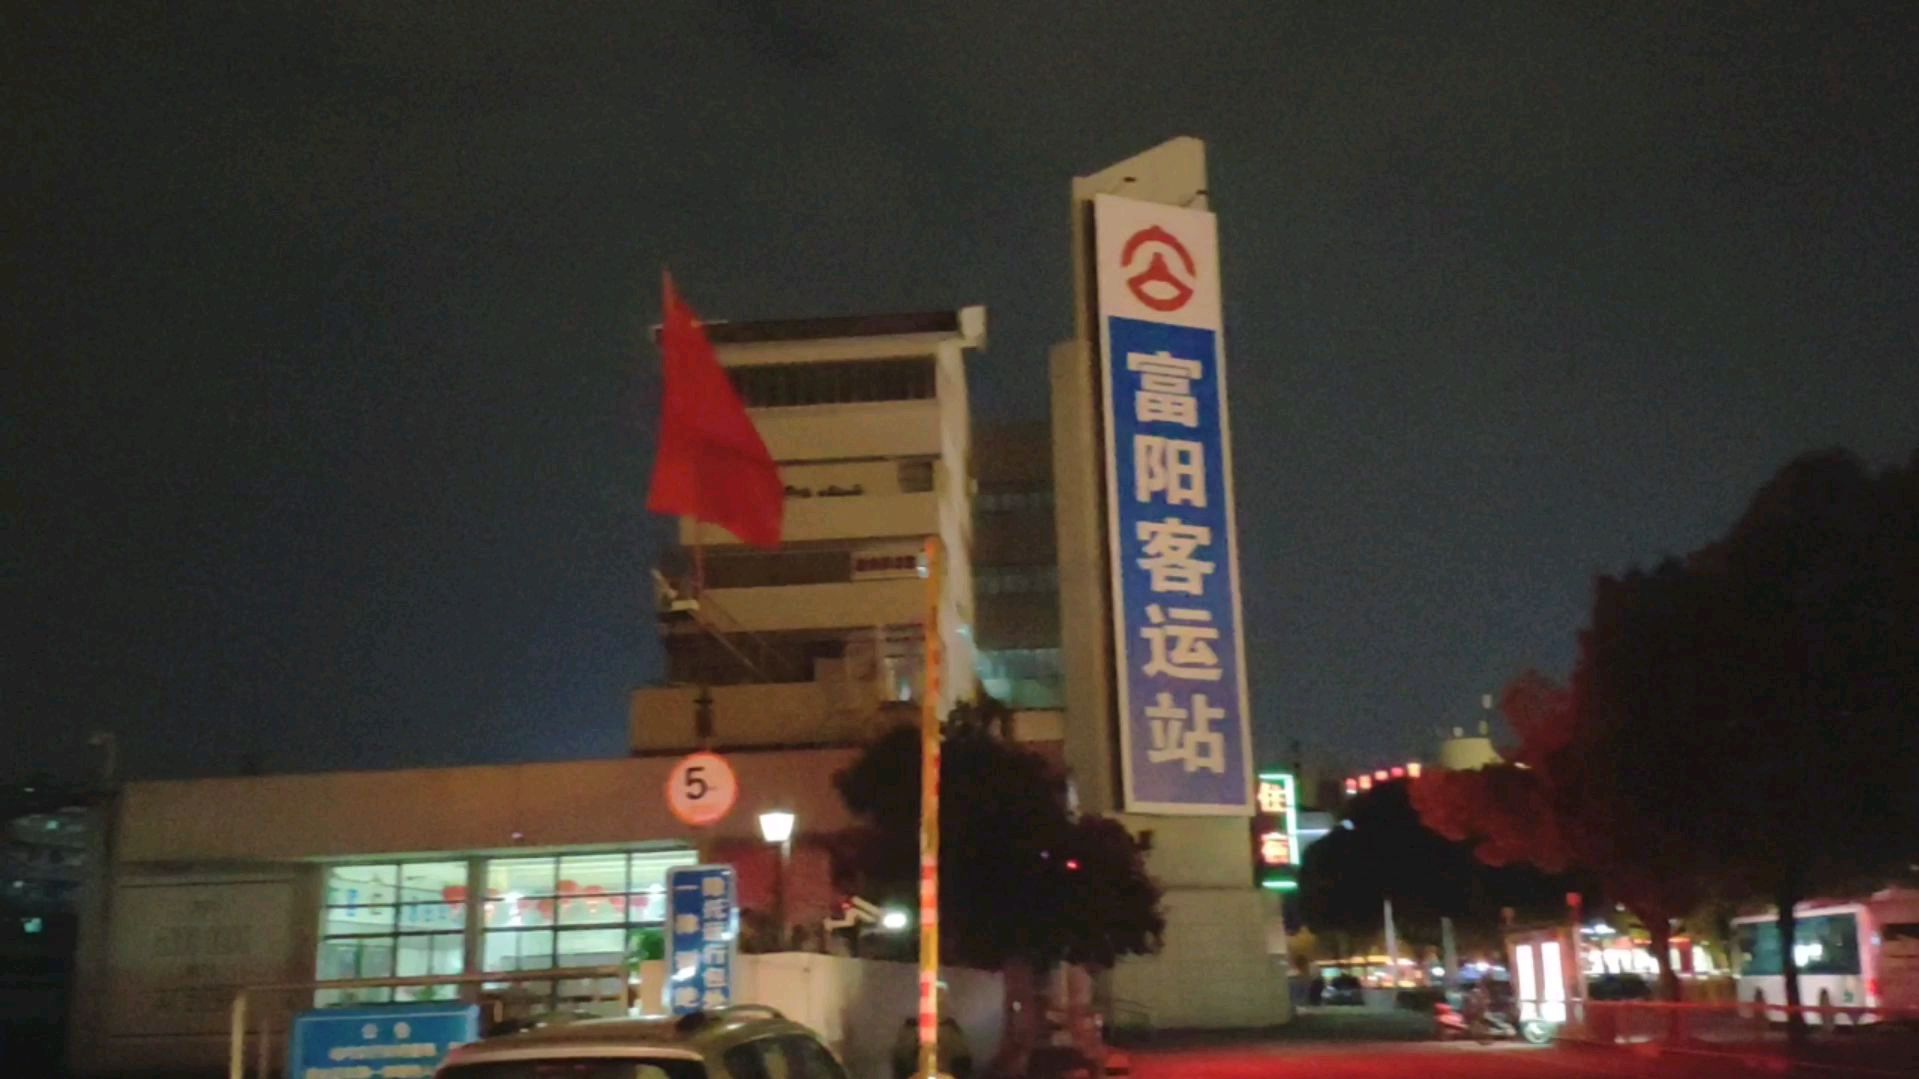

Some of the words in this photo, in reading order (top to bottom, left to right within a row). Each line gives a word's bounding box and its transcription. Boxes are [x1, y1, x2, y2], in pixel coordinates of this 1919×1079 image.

[1127, 350, 1225, 775] 富阳客运站
[685, 766, 708, 800] 5
